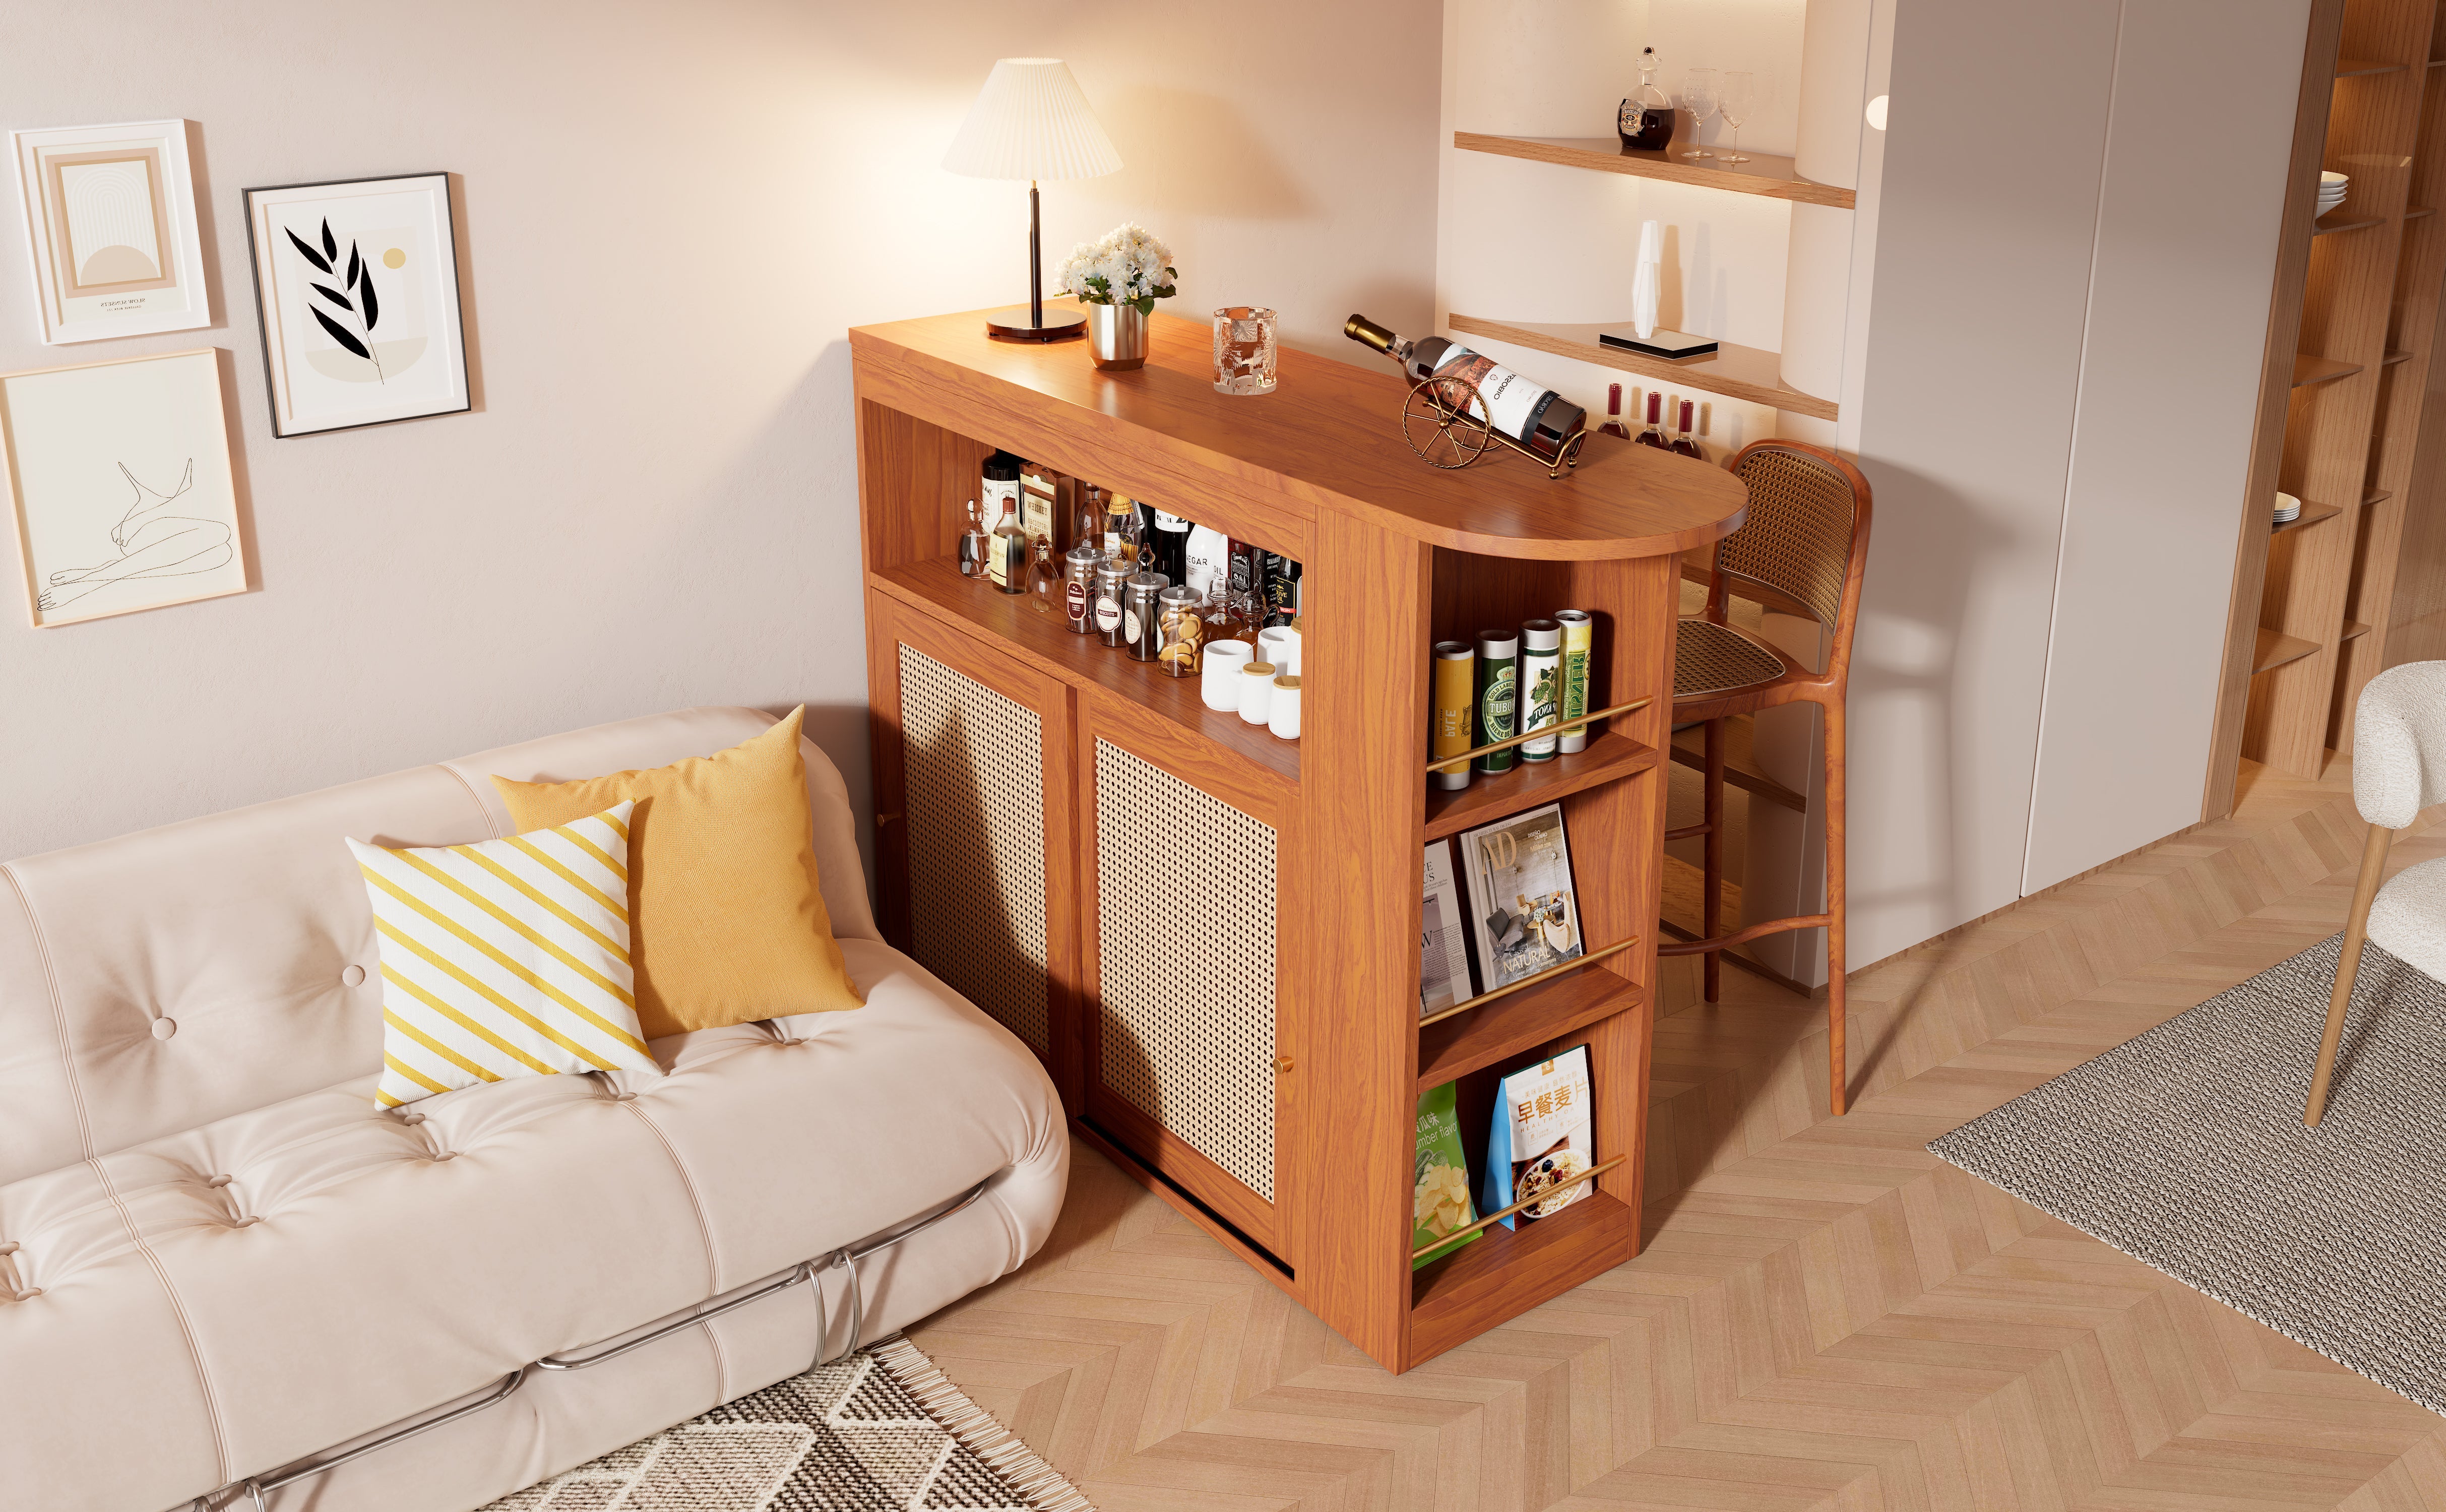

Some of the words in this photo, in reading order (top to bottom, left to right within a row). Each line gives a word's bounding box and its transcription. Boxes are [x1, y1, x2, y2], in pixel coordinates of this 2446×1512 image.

[1027, 501, 1047, 516] WHISKEY
[1214, 565, 1223, 576] OIL
[1489, 688, 1500, 700] GOLD
[1490, 722, 1504, 738] BIERE
[1473, 825, 1499, 838] ARCHITECTURAL
[1528, 830, 1540, 838] DISEÑO
[1534, 832, 1547, 840] QUIERO
[1481, 832, 1517, 875] AD
[1530, 844, 1543, 853] Milán
[1509, 949, 1523, 957] Casas
[1524, 943, 1529, 952] al
[1503, 946, 1550, 974] NATURAL
[1537, 958, 1556, 968] Formentera
[1518, 1077, 1589, 1124] 早餐麦片
[1521, 1114, 1558, 1133] HEALTHY
[1416, 1131, 1438, 1150] umber
